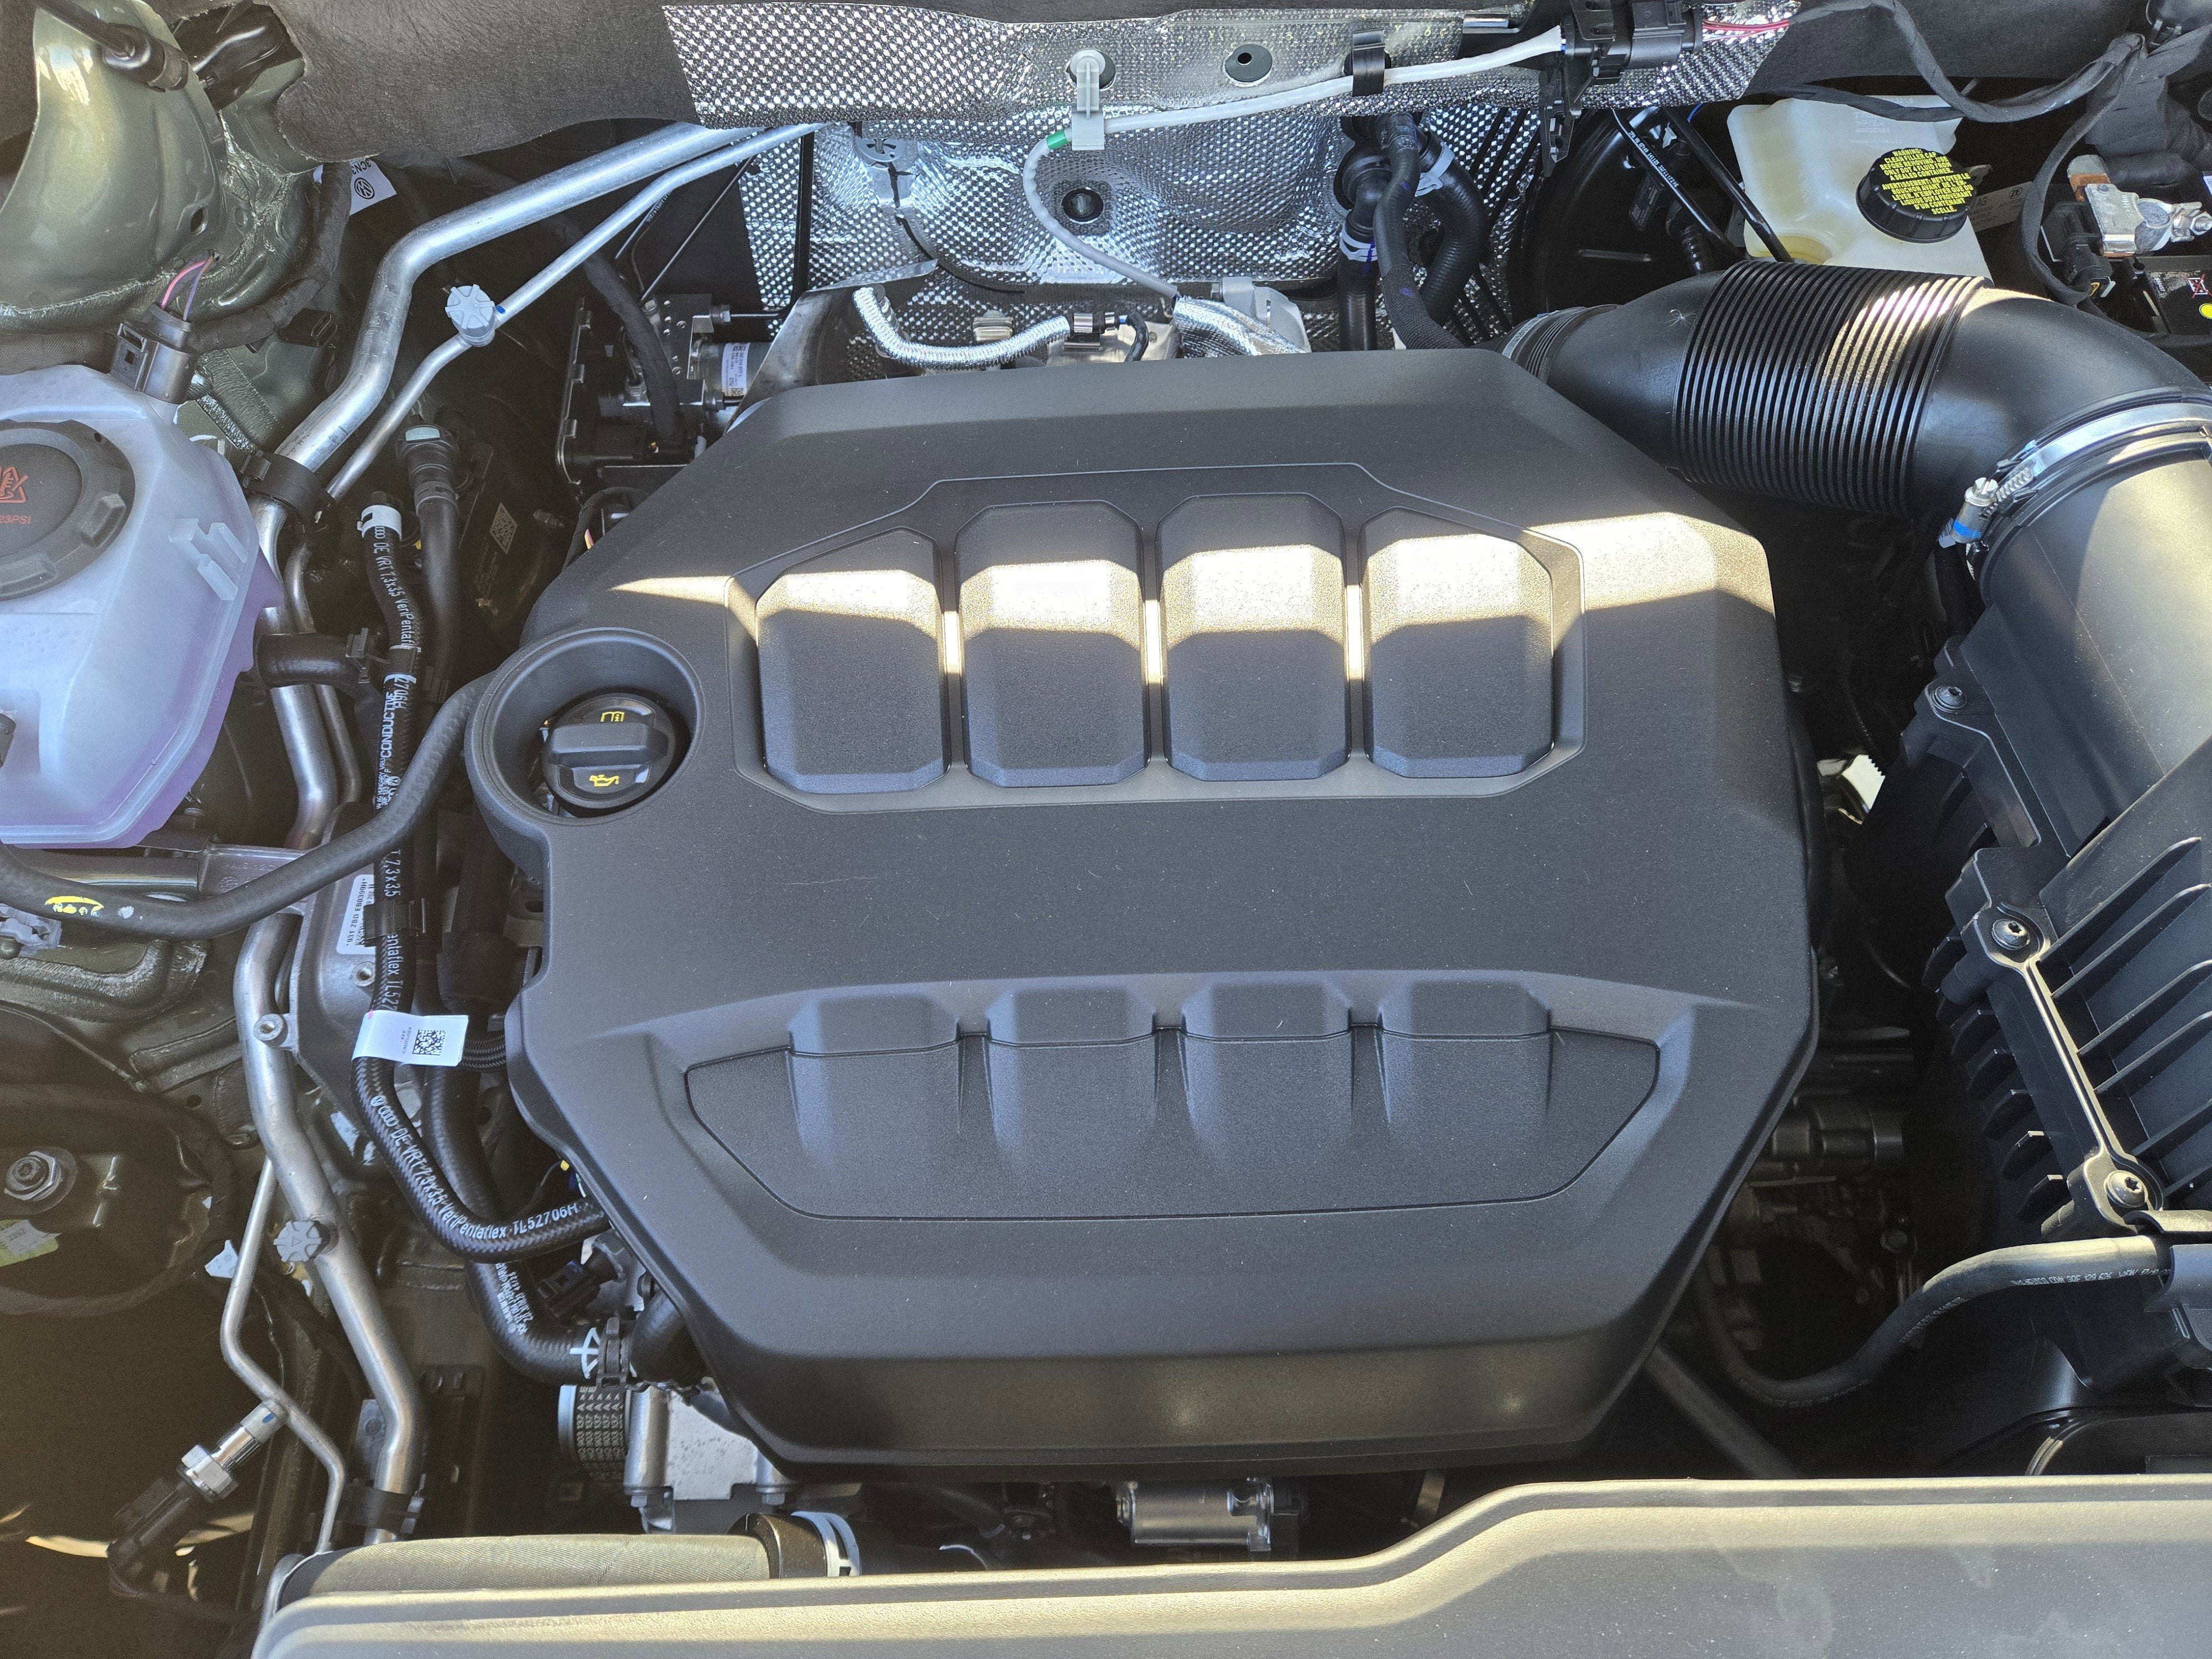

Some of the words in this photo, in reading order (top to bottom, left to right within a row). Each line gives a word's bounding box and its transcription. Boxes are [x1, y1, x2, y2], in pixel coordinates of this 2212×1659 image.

[1892, 148, 1923, 156] WARNING:
[1880, 162, 1904, 170] BEFORE
[1902, 159, 1936, 167] REMOVING.
[1894, 172, 1918, 180] SEALED
[1917, 168, 1954, 177] CONTAINER.
[1882, 179, 1932, 190] AVERTISSEMENT:
[1931, 174, 1962, 184] NETTOYER
[1891, 186, 1922, 195] BOUCHON
[1921, 182, 1941, 191] AVANT
[1892, 192, 1914, 201] LEVER.
[1913, 187, 1952, 198] N'EMPLOYER
[1900, 197, 1924, 206] LIQUIDE
[1938, 190, 1973, 201] PROVENANT
[1929, 197, 1965, 208] CONTENANT
[375, 556, 394, 570] VRT
[380, 691, 395, 759] CONDUCTIVE
[351, 912, 359, 928] ZBD
[401, 1144, 428, 1168] VRT
[513, 1202, 578, 1235] TL52706H
